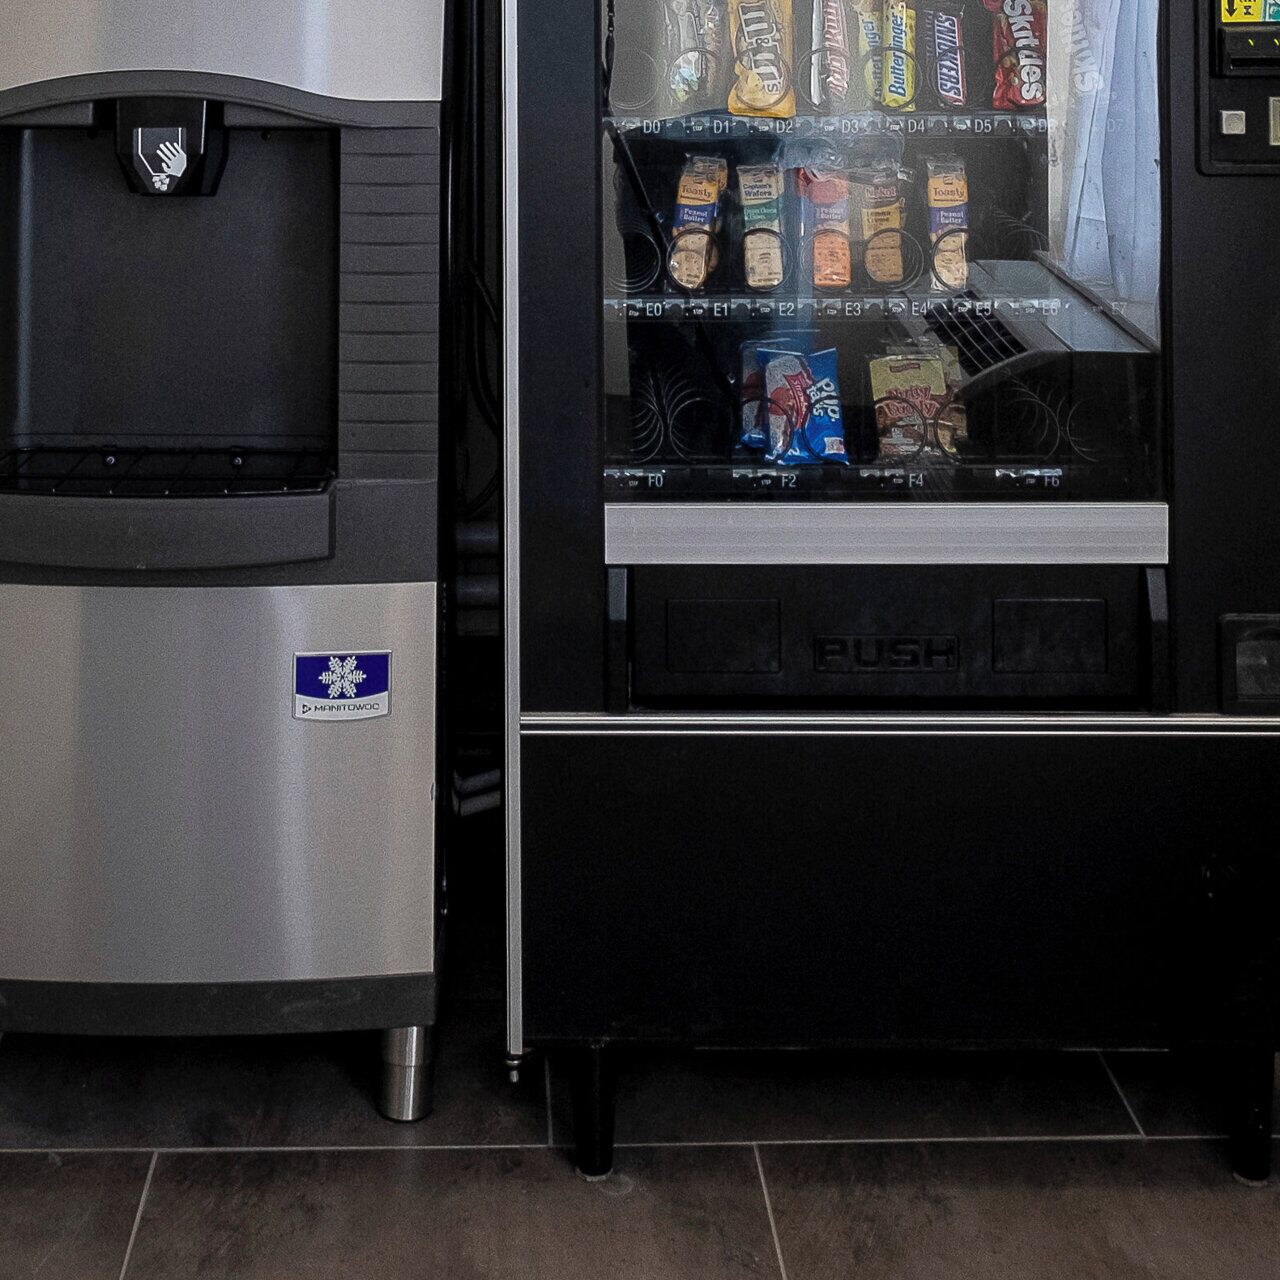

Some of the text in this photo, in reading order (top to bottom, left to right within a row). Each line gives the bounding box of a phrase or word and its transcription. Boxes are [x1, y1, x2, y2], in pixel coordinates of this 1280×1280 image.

[643, 120, 661, 134] D0
[713, 120, 730, 134] D1
[776, 120, 793, 134] D2
[842, 120, 859, 134] D3
[908, 119, 925, 133] D4
[974, 119, 992, 133] D5
[681, 184, 713, 198] Toasty
[744, 190, 772, 198] Wafers
[933, 187, 965, 198] Toasty
[646, 303, 662, 316] E0
[713, 302, 728, 316] E1
[779, 302, 795, 316] E2
[845, 303, 861, 316] E3
[912, 302, 927, 315] E4
[976, 302, 992, 315] E5
[1042, 302, 1058, 315] E6
[648, 473, 663, 487] F0
[781, 473, 796, 487] F2
[909, 473, 923, 487] F4
[1044, 473, 1059, 487] F6
[820, 637, 956, 670] PUSH
[314, 702, 380, 712] MANITOWOC
